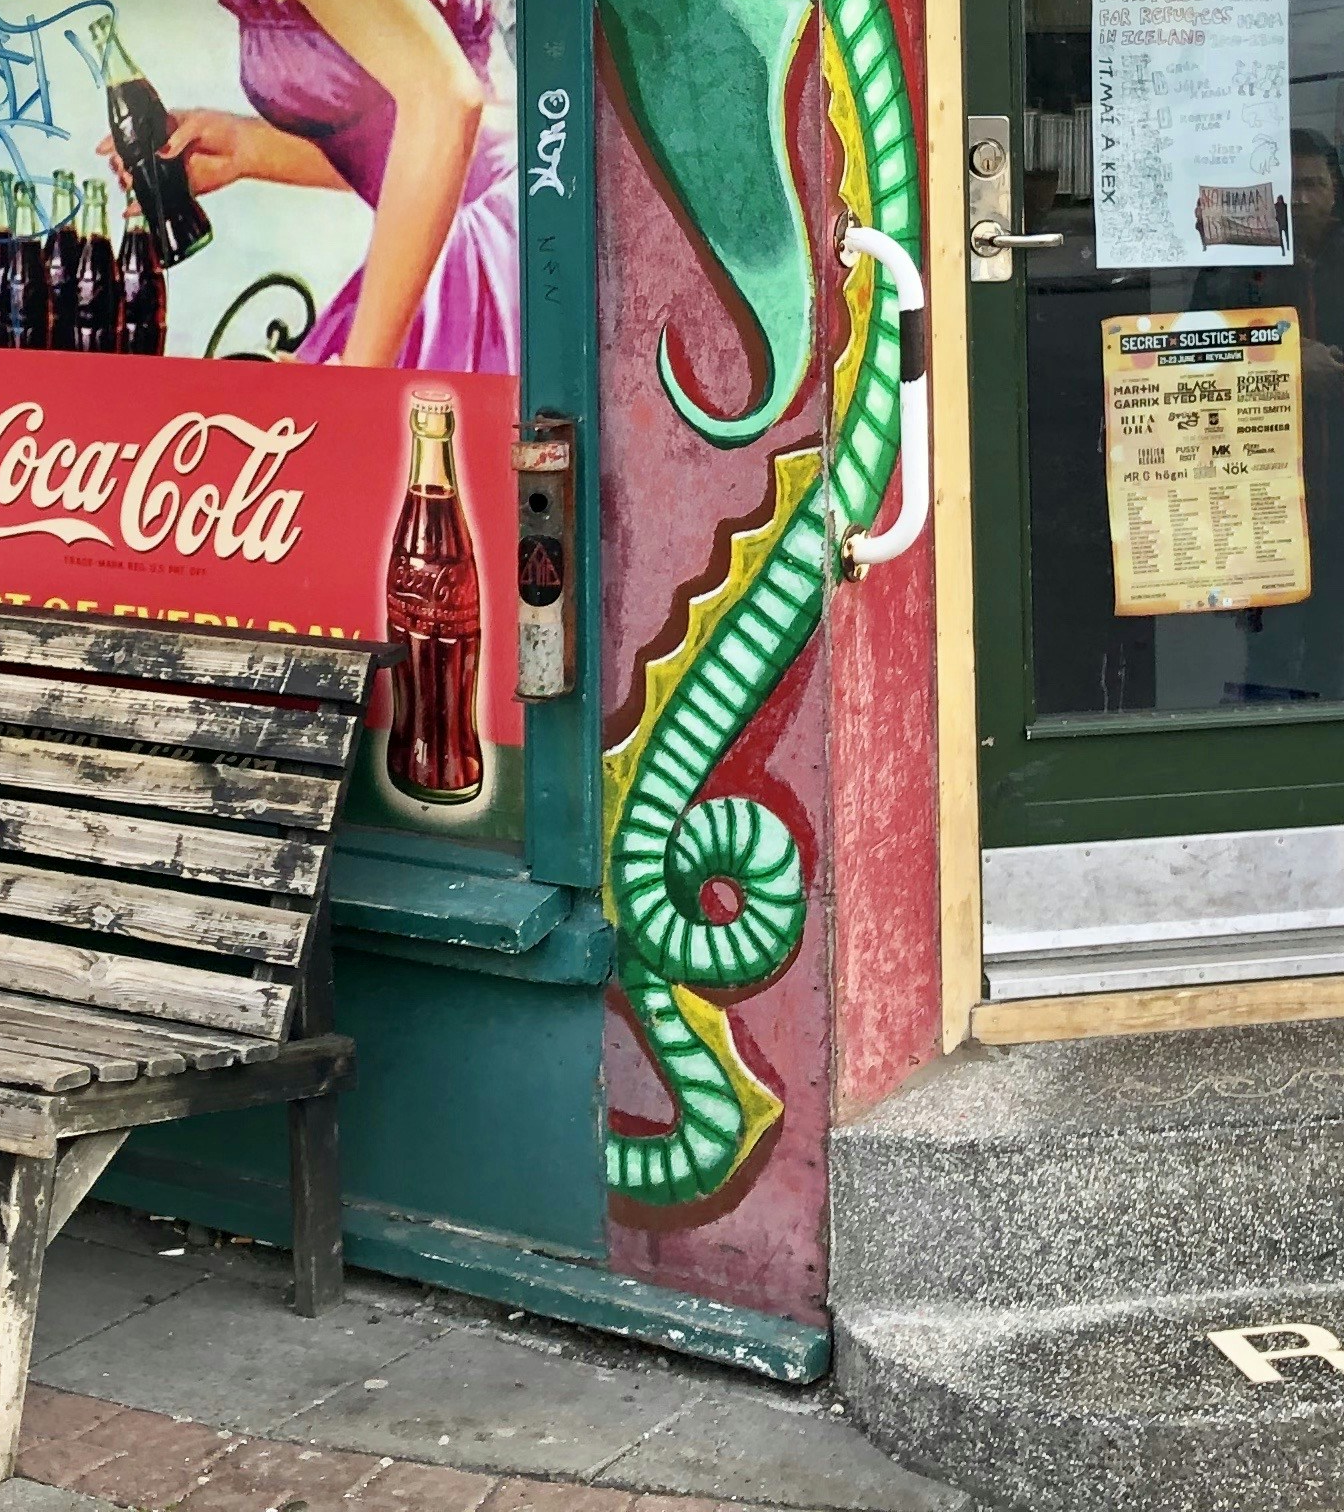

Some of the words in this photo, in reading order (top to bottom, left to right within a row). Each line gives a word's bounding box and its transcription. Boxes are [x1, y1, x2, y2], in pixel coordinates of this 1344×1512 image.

[1122, 335, 1168, 350] SECRET
[1180, 331, 1236, 346] SOLSTICE
[1114, 397, 1160, 409] GARRIX
